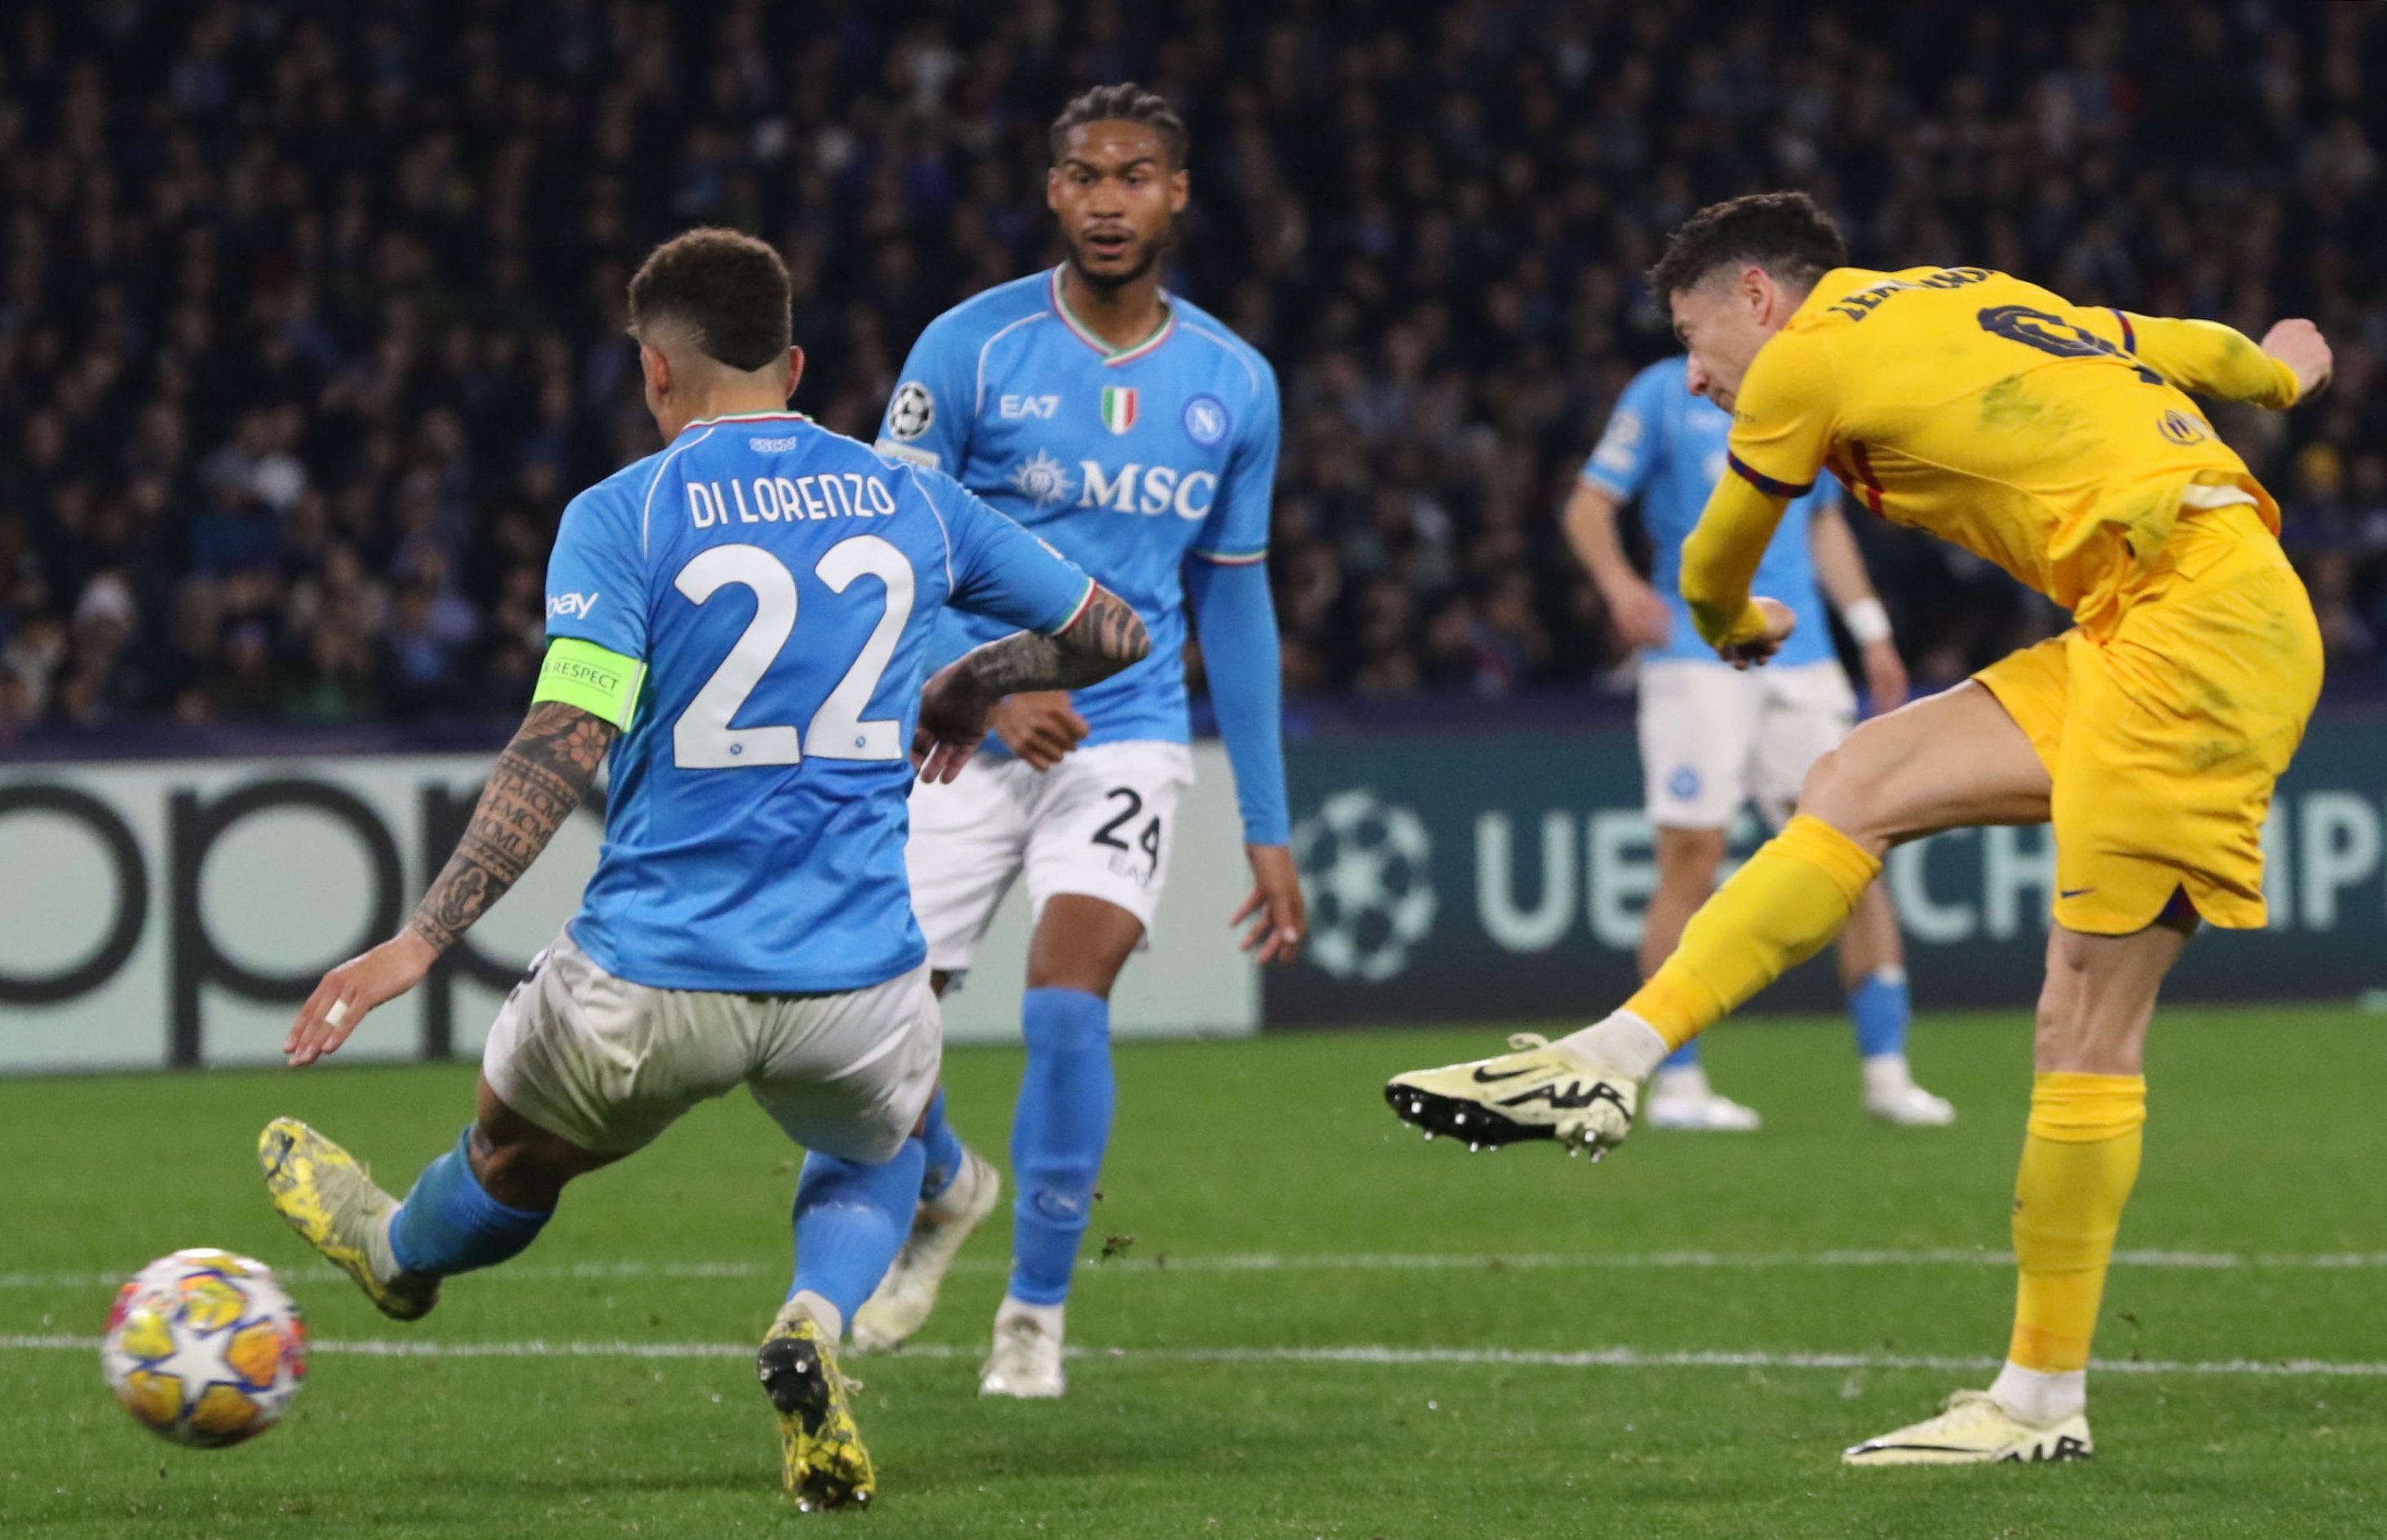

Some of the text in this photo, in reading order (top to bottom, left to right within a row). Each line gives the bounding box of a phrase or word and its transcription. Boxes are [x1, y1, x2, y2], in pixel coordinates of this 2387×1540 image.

[1000, 394, 1059, 419] EA7
[687, 474, 896, 528] DI LORENZO
[1076, 460, 1220, 520] MSC
[552, 661, 620, 691] RESPECT
[674, 534, 915, 769] 22
[1090, 788, 1160, 880] 24
